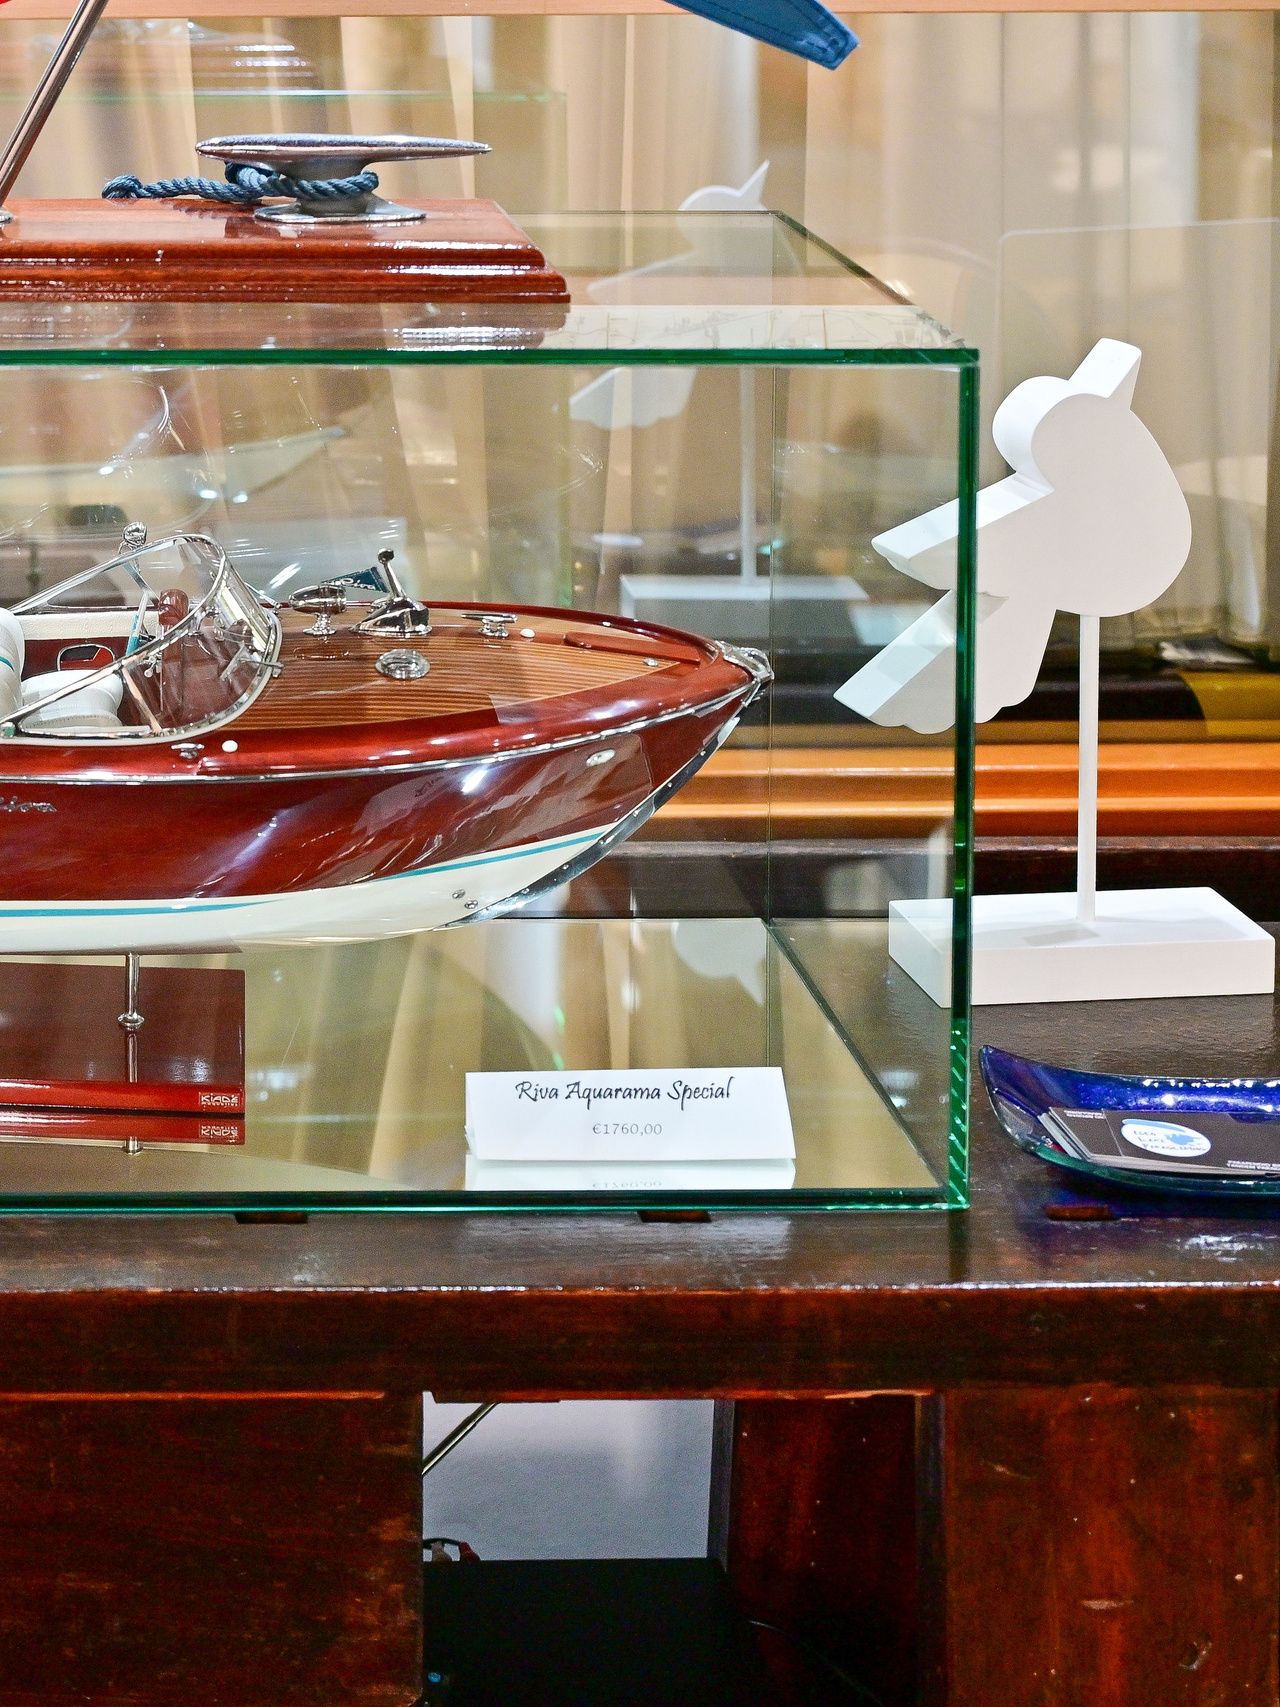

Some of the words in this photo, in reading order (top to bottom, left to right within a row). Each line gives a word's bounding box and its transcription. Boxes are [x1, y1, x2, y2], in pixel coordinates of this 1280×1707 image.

[515, 1080, 559, 1102] Riva
[565, 1080, 661, 1110] Aquarama
[667, 1076, 735, 1111] Special
[592, 1123, 663, 1137] €1760,00
